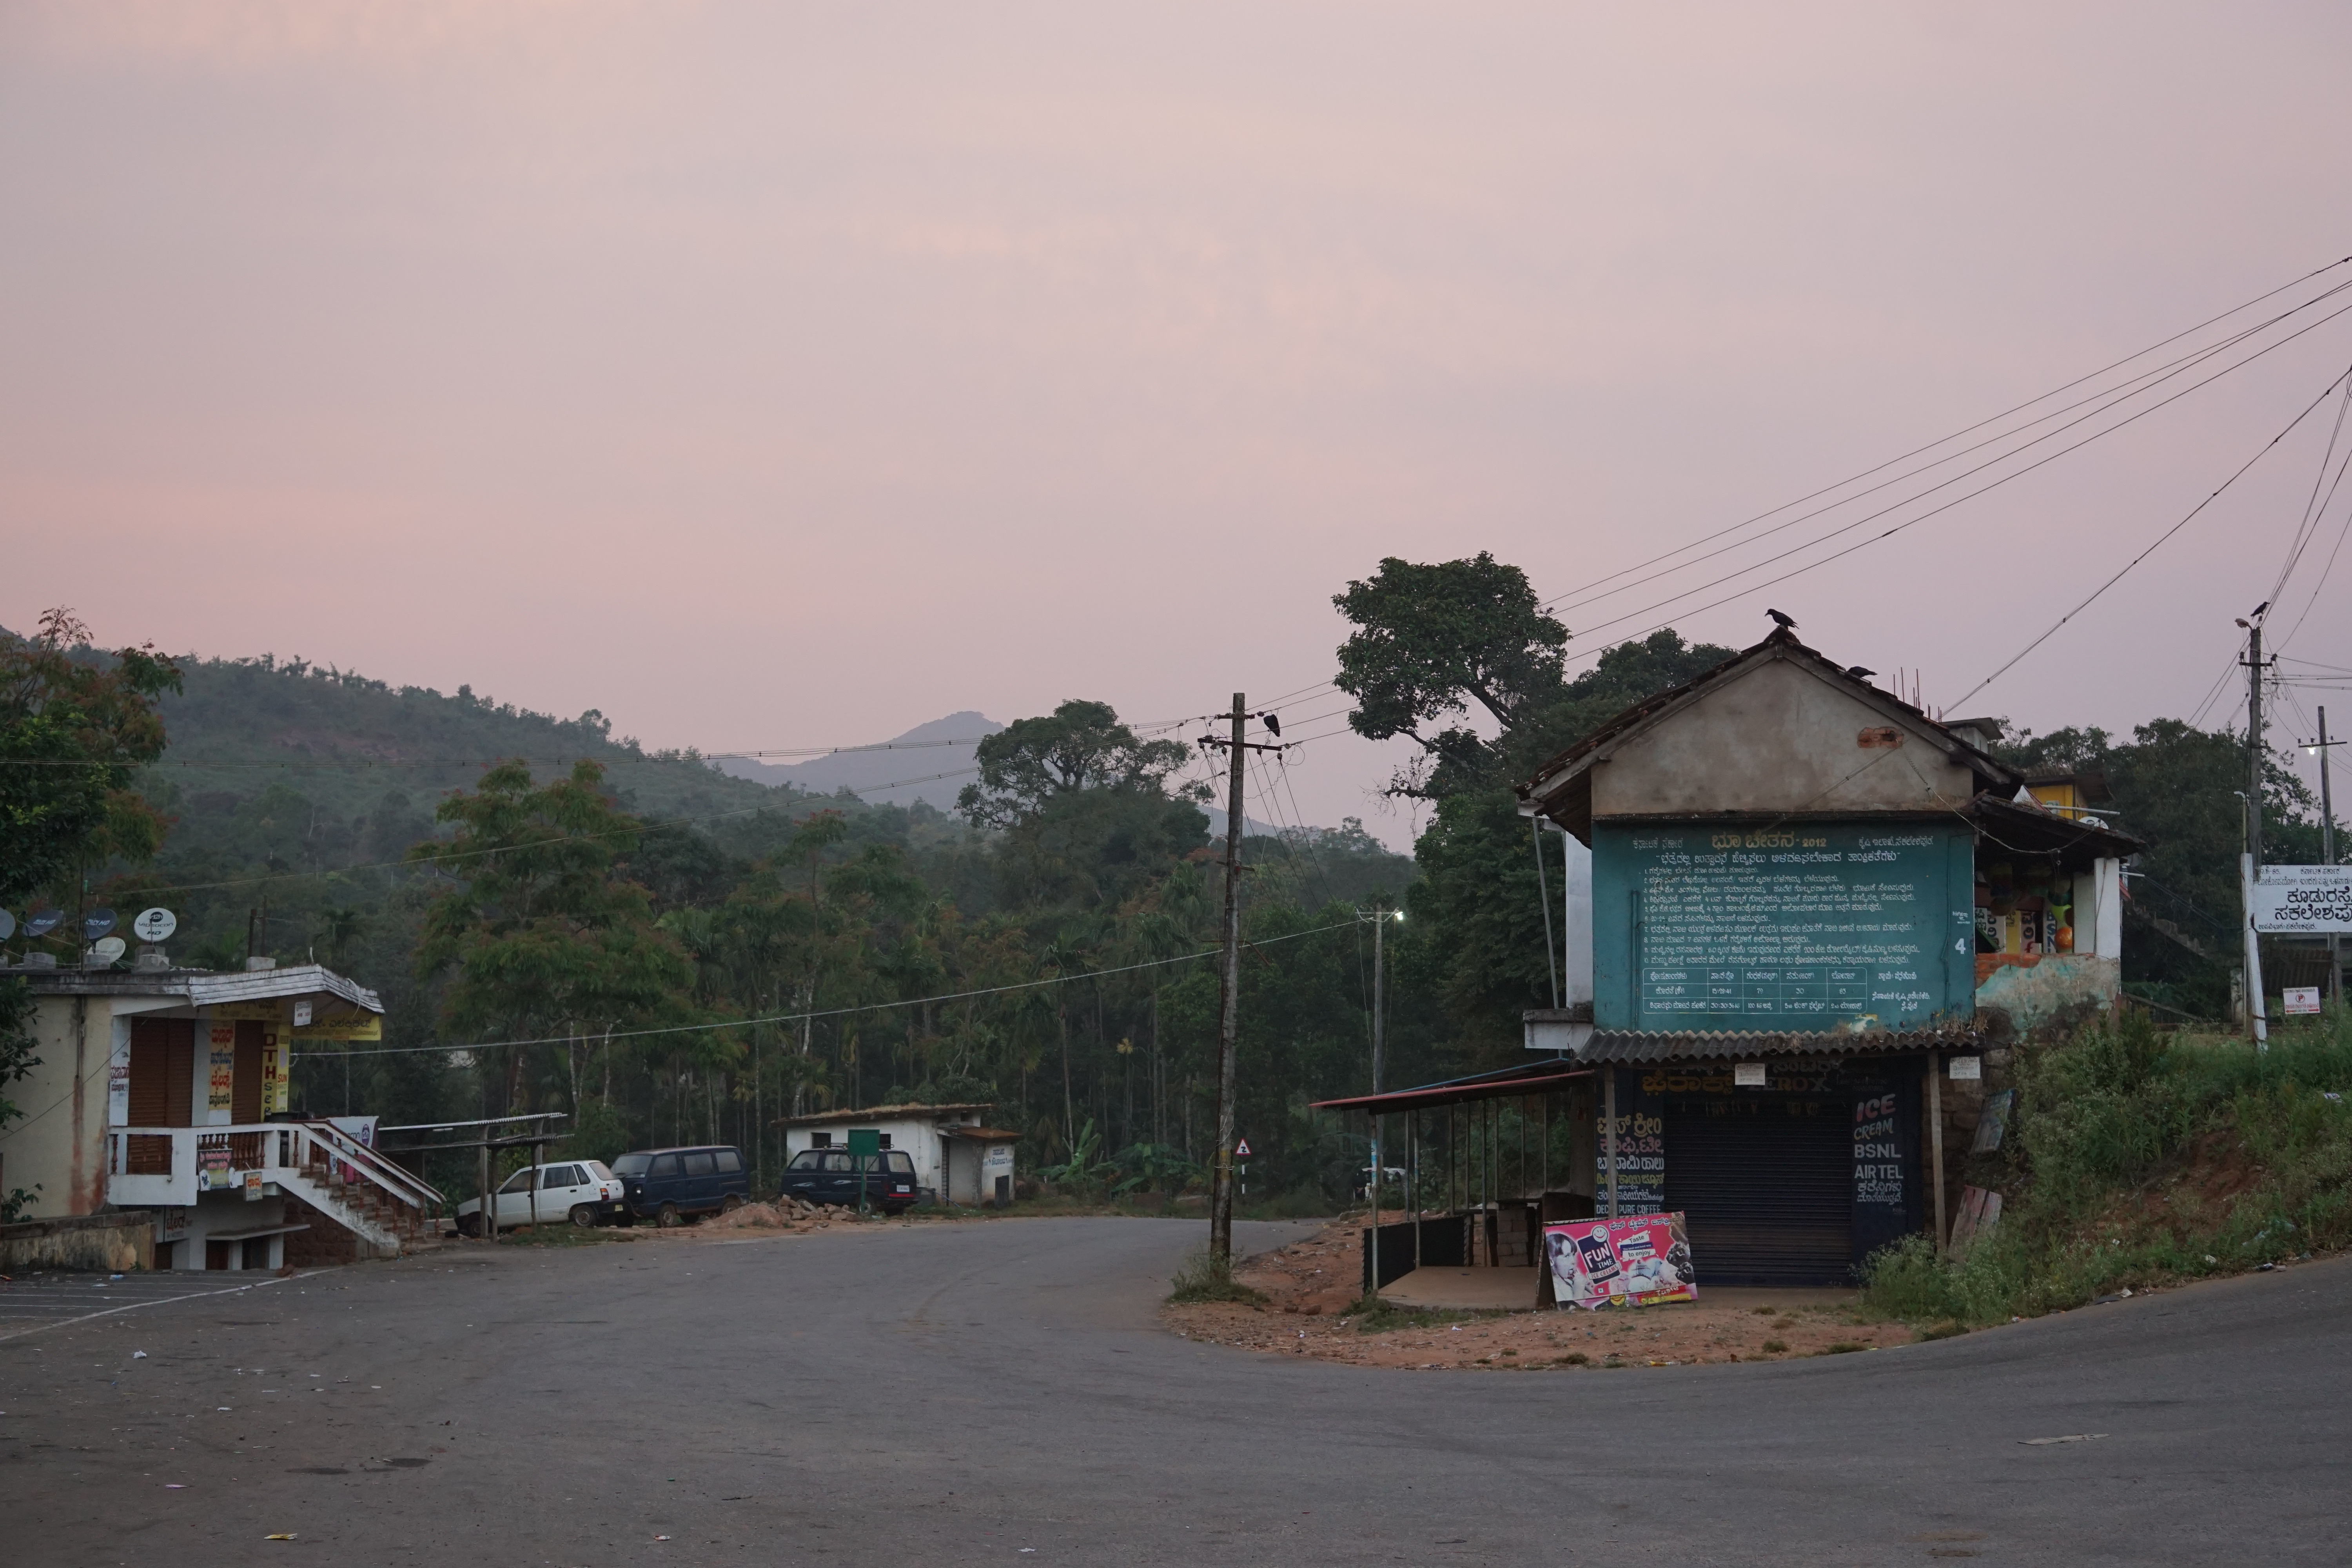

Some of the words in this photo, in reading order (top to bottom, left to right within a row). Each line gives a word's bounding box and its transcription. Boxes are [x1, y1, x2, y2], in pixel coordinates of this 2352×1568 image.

[1802, 838, 1827, 847] 2012
[2275, 903, 2352, 922] ಸಕಲೇಶಪು
[1955, 938, 1966, 955] 4
[278, 1074, 288, 1083] SUN
[1748, 1076, 1833, 1091] EROX
[1857, 1093, 1896, 1122] ICE
[1854, 1118, 1894, 1140] CREAM
[1854, 1143, 1902, 1158] BSNL
[1619, 1204, 1636, 1214] PURE
[1637, 1204, 1661, 1214] COFFEE
[1628, 1234, 1645, 1244] Taste
[1584, 1243, 1609, 1269] FUN
[1597, 1258, 1614, 1269] TIME
[1591, 1272, 1600, 1280] ICE
[1601, 1265, 1619, 1277] CREAMS
